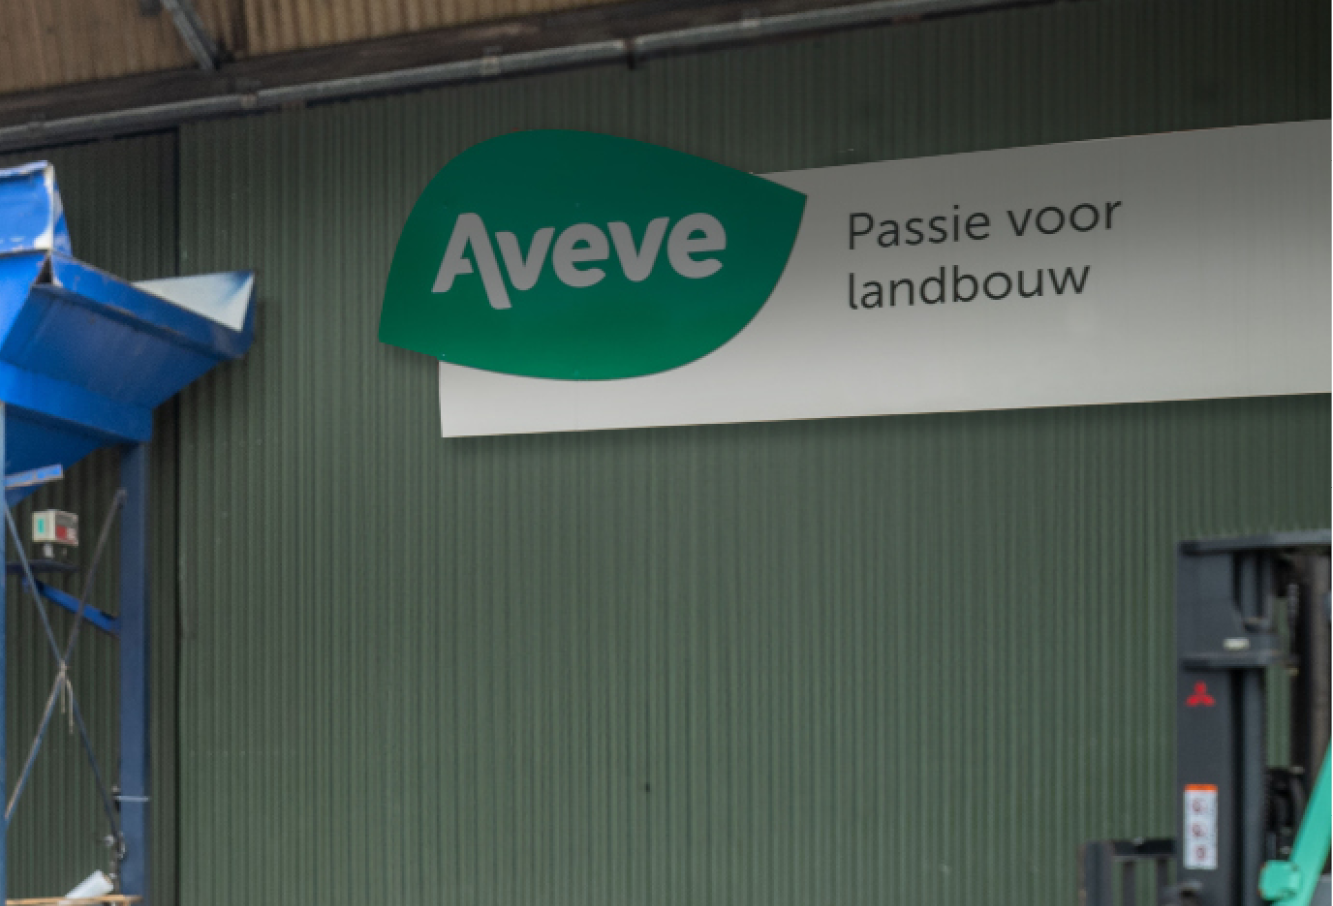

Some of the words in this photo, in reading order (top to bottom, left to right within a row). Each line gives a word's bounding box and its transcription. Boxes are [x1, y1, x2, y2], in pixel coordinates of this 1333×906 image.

[847, 205, 991, 250] Passie
[1006, 198, 1122, 237] voor
[431, 212, 727, 311] Aveve
[847, 262, 1091, 310] landbouw
